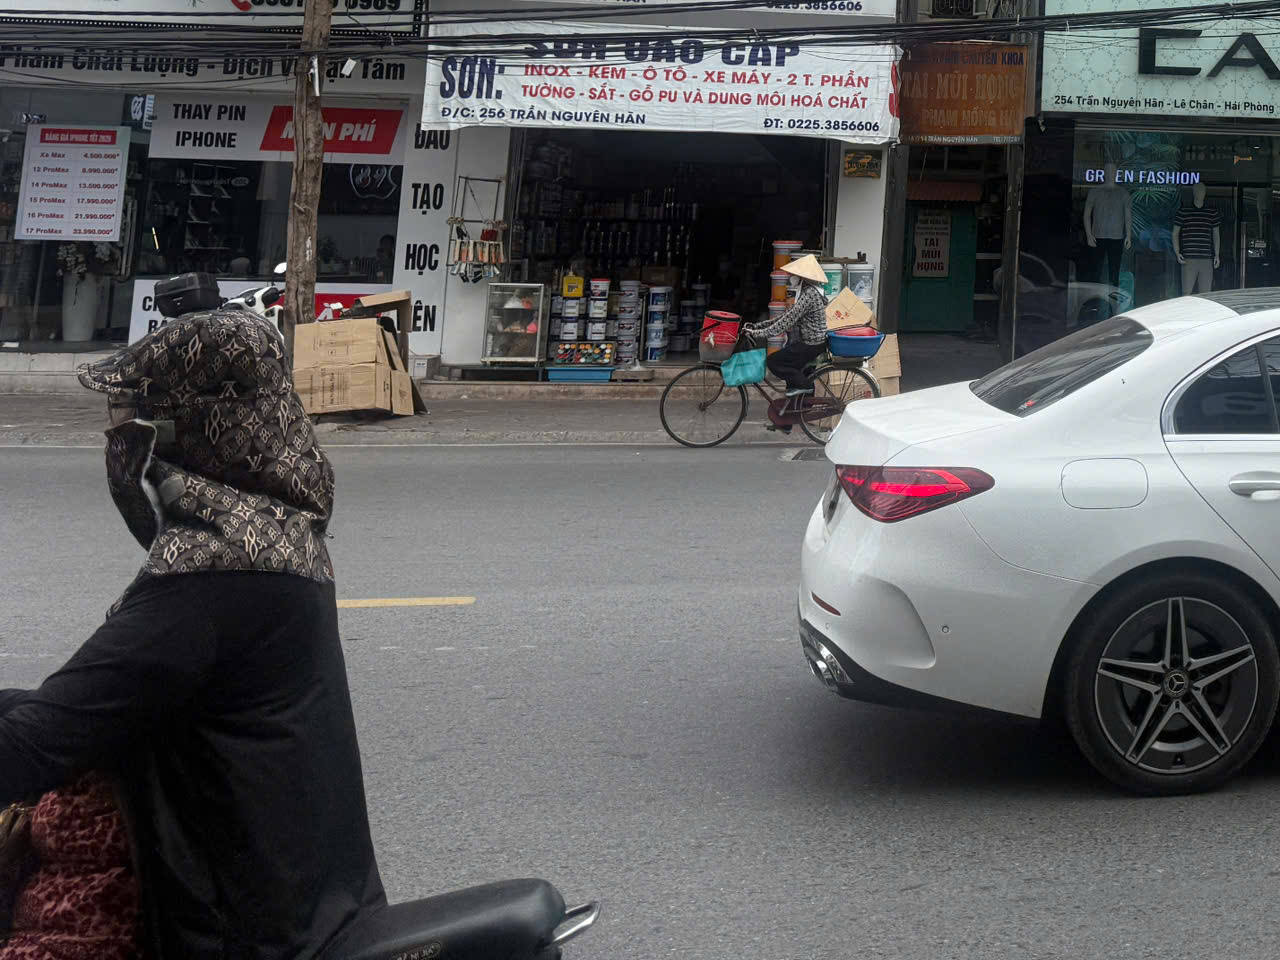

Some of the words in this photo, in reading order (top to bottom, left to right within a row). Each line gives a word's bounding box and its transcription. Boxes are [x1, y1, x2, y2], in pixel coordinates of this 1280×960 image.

[361, 58, 406, 81] Tâm
[525, 64, 571, 77] INOX
[643, 66, 658, 81] Ô
[664, 66, 687, 82] TÔ
[703, 70, 725, 84] XE
[731, 68, 771, 85] MÁY
[787, 74, 797, 86] 2
[803, 74, 814, 87] T.
[821, 69, 869, 88] PHẦN
[522, 83, 575, 99] TƯỜNG
[588, 82, 616, 101] SẮT
[629, 85, 654, 102] GỖ
[659, 91, 677, 103] PU
[683, 88, 704, 104] VÀ
[708, 92, 752, 105] DUNG
[757, 90, 786, 107] MÔI
[791, 92, 823, 108] HOÁ
[828, 91, 868, 109] CHẤT
[1054, 95, 1073, 105] 254
[1174, 98, 1187, 109] Lê
[1189, 98, 1214, 109] Chân
[1243, 100, 1275, 114] Phòng
[173, 103, 213, 121] THAY
[216, 105, 247, 121] PIN
[441, 107, 475, 118] Đ/C:
[479, 108, 505, 119] 256
[510, 104, 547, 121] TRẦN
[551, 109, 610, 123] NGUYÊN
[615, 111, 646, 125] HÃN
[338, 119, 377, 142] PHÍ
[764, 119, 783, 130] ĐT:
[787, 119, 880, 132] 0225.3856606
[175, 130, 237, 148] IPHONE
[1085, 168, 1134, 183] GREN
[1139, 170, 1200, 185] FASHION
[411, 183, 444, 215] TẠO
[404, 243, 440, 276] HỌC
